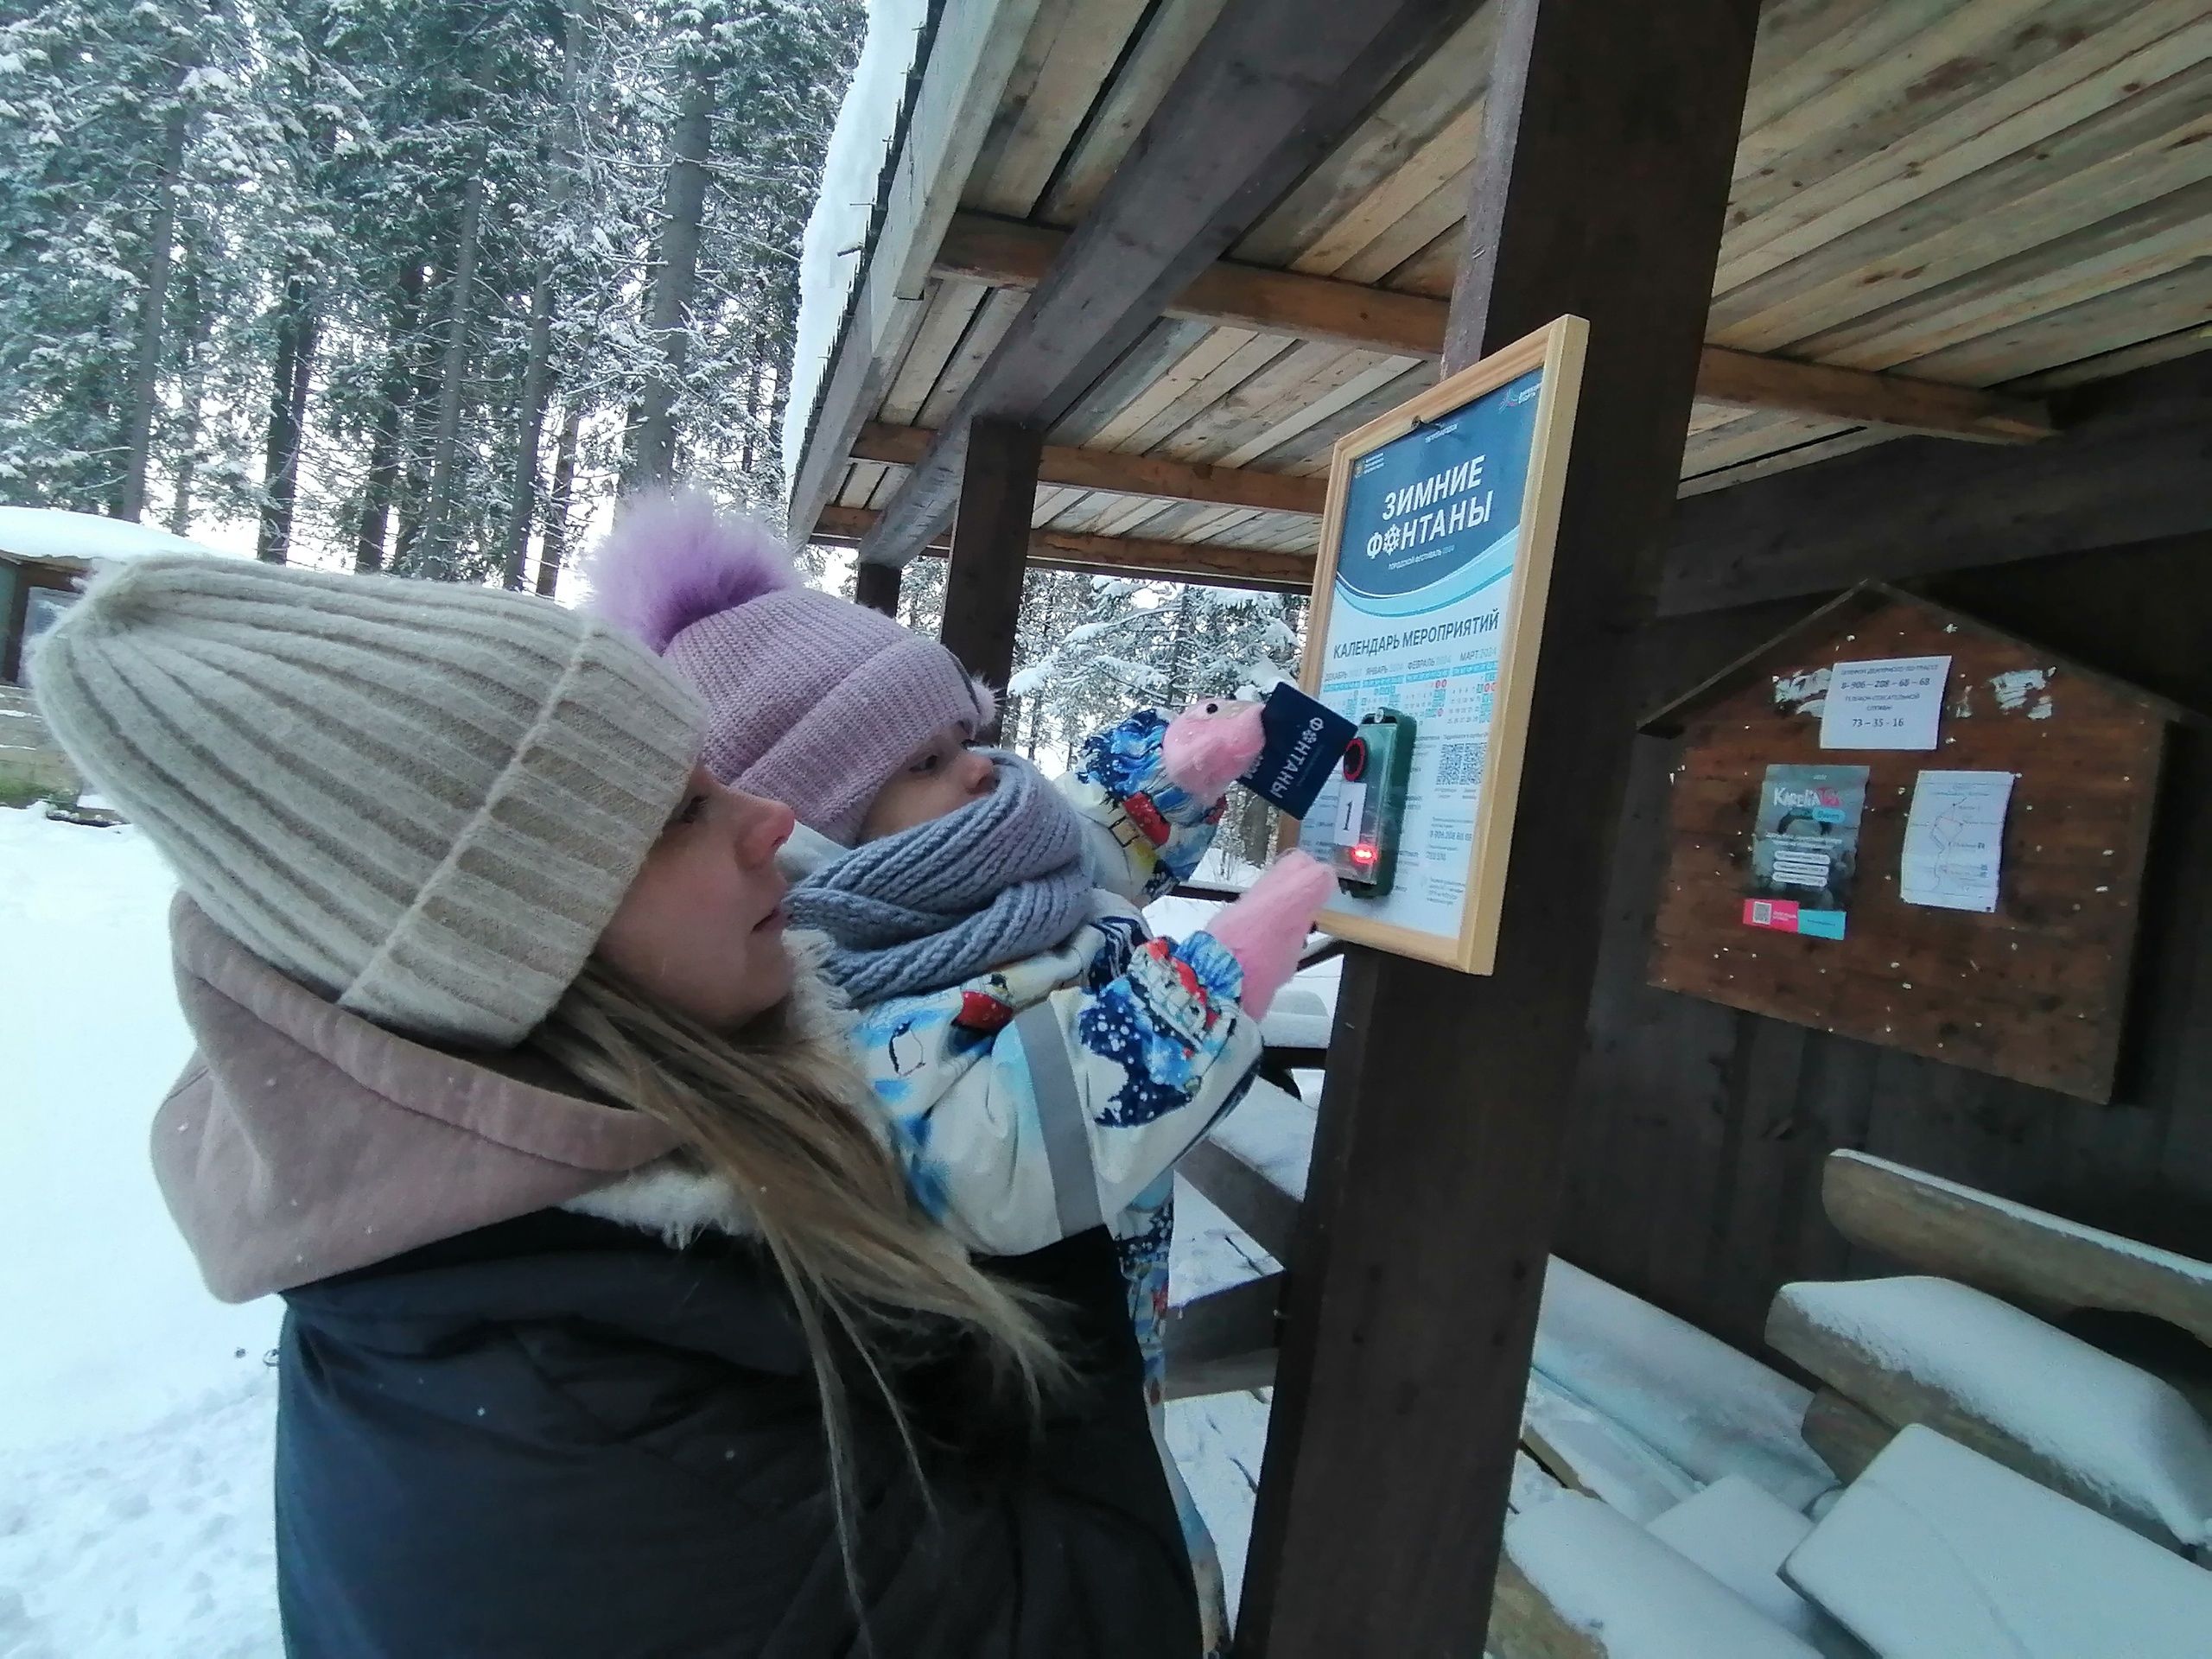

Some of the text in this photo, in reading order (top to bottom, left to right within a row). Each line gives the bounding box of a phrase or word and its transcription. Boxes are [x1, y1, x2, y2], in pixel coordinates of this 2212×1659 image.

[1382, 454, 1485, 520] ЗИМНИЕ
[1333, 608, 1500, 658] КАЛЕНДАРЬ МЕРОПРИЯТИЙ
[1459, 650, 1479, 662] МАРТ
[1365, 665, 1389, 676] ЯНВАРЬ
[1408, 658, 1435, 671] ФЕВРАЛЬ
[1324, 671, 1348, 682] ДЕКАБРЬ
[1852, 719, 1863, 728] 73
[1872, 718, 1884, 727] 35
[1892, 718, 1904, 727] 16
[1342, 800, 1354, 831] 1
